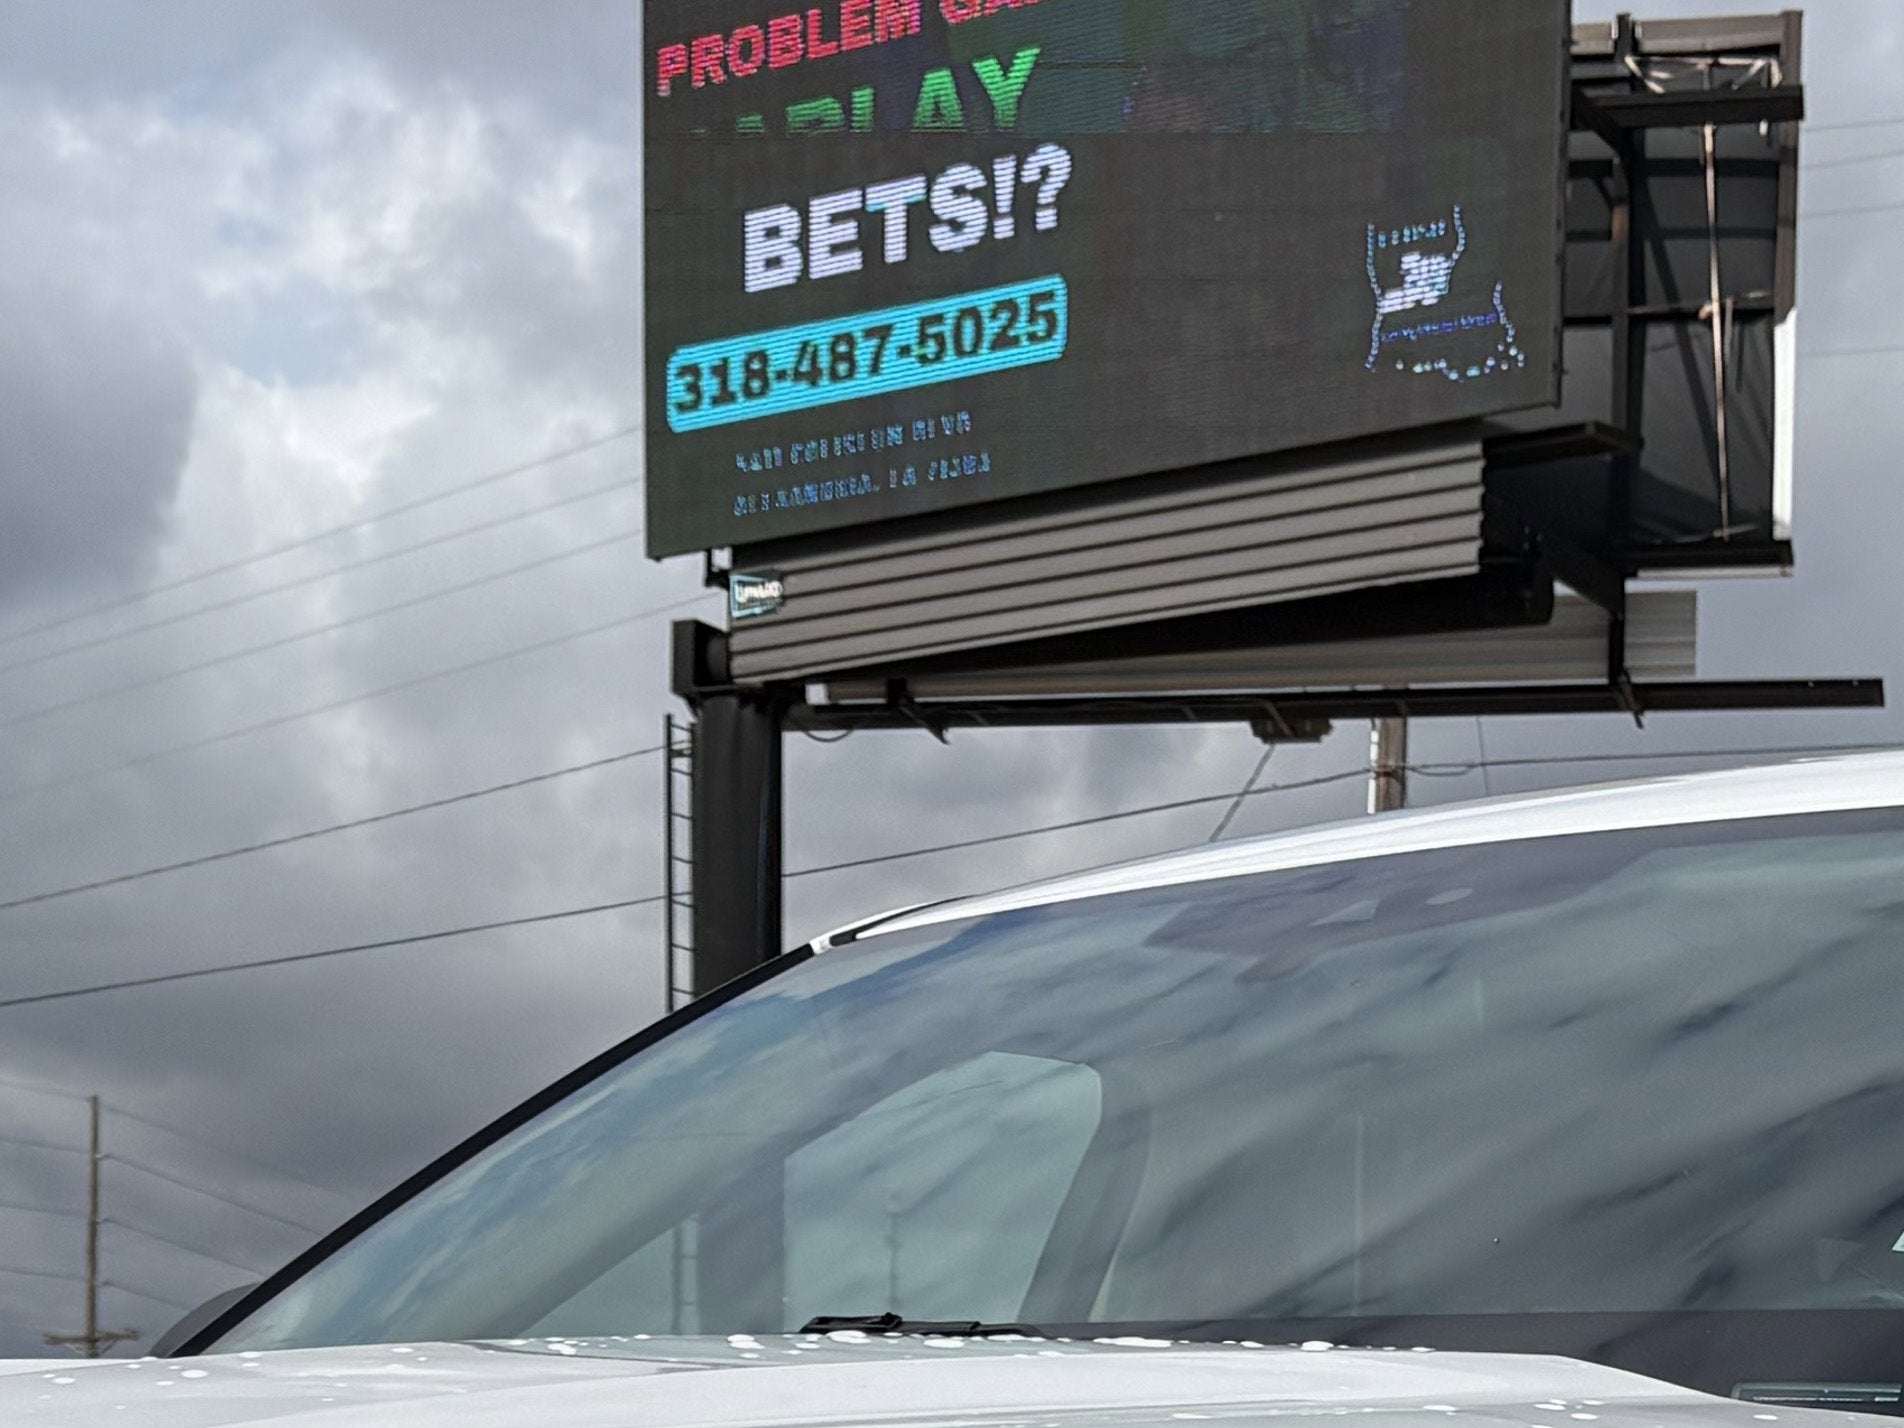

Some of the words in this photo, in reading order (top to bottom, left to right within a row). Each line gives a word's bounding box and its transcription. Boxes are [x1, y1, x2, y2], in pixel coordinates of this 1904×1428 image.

[657, 0, 922, 97] PROBLEM
[744, 143, 1073, 293] BETS!?
[673, 291, 1060, 415] 318-487-5025
